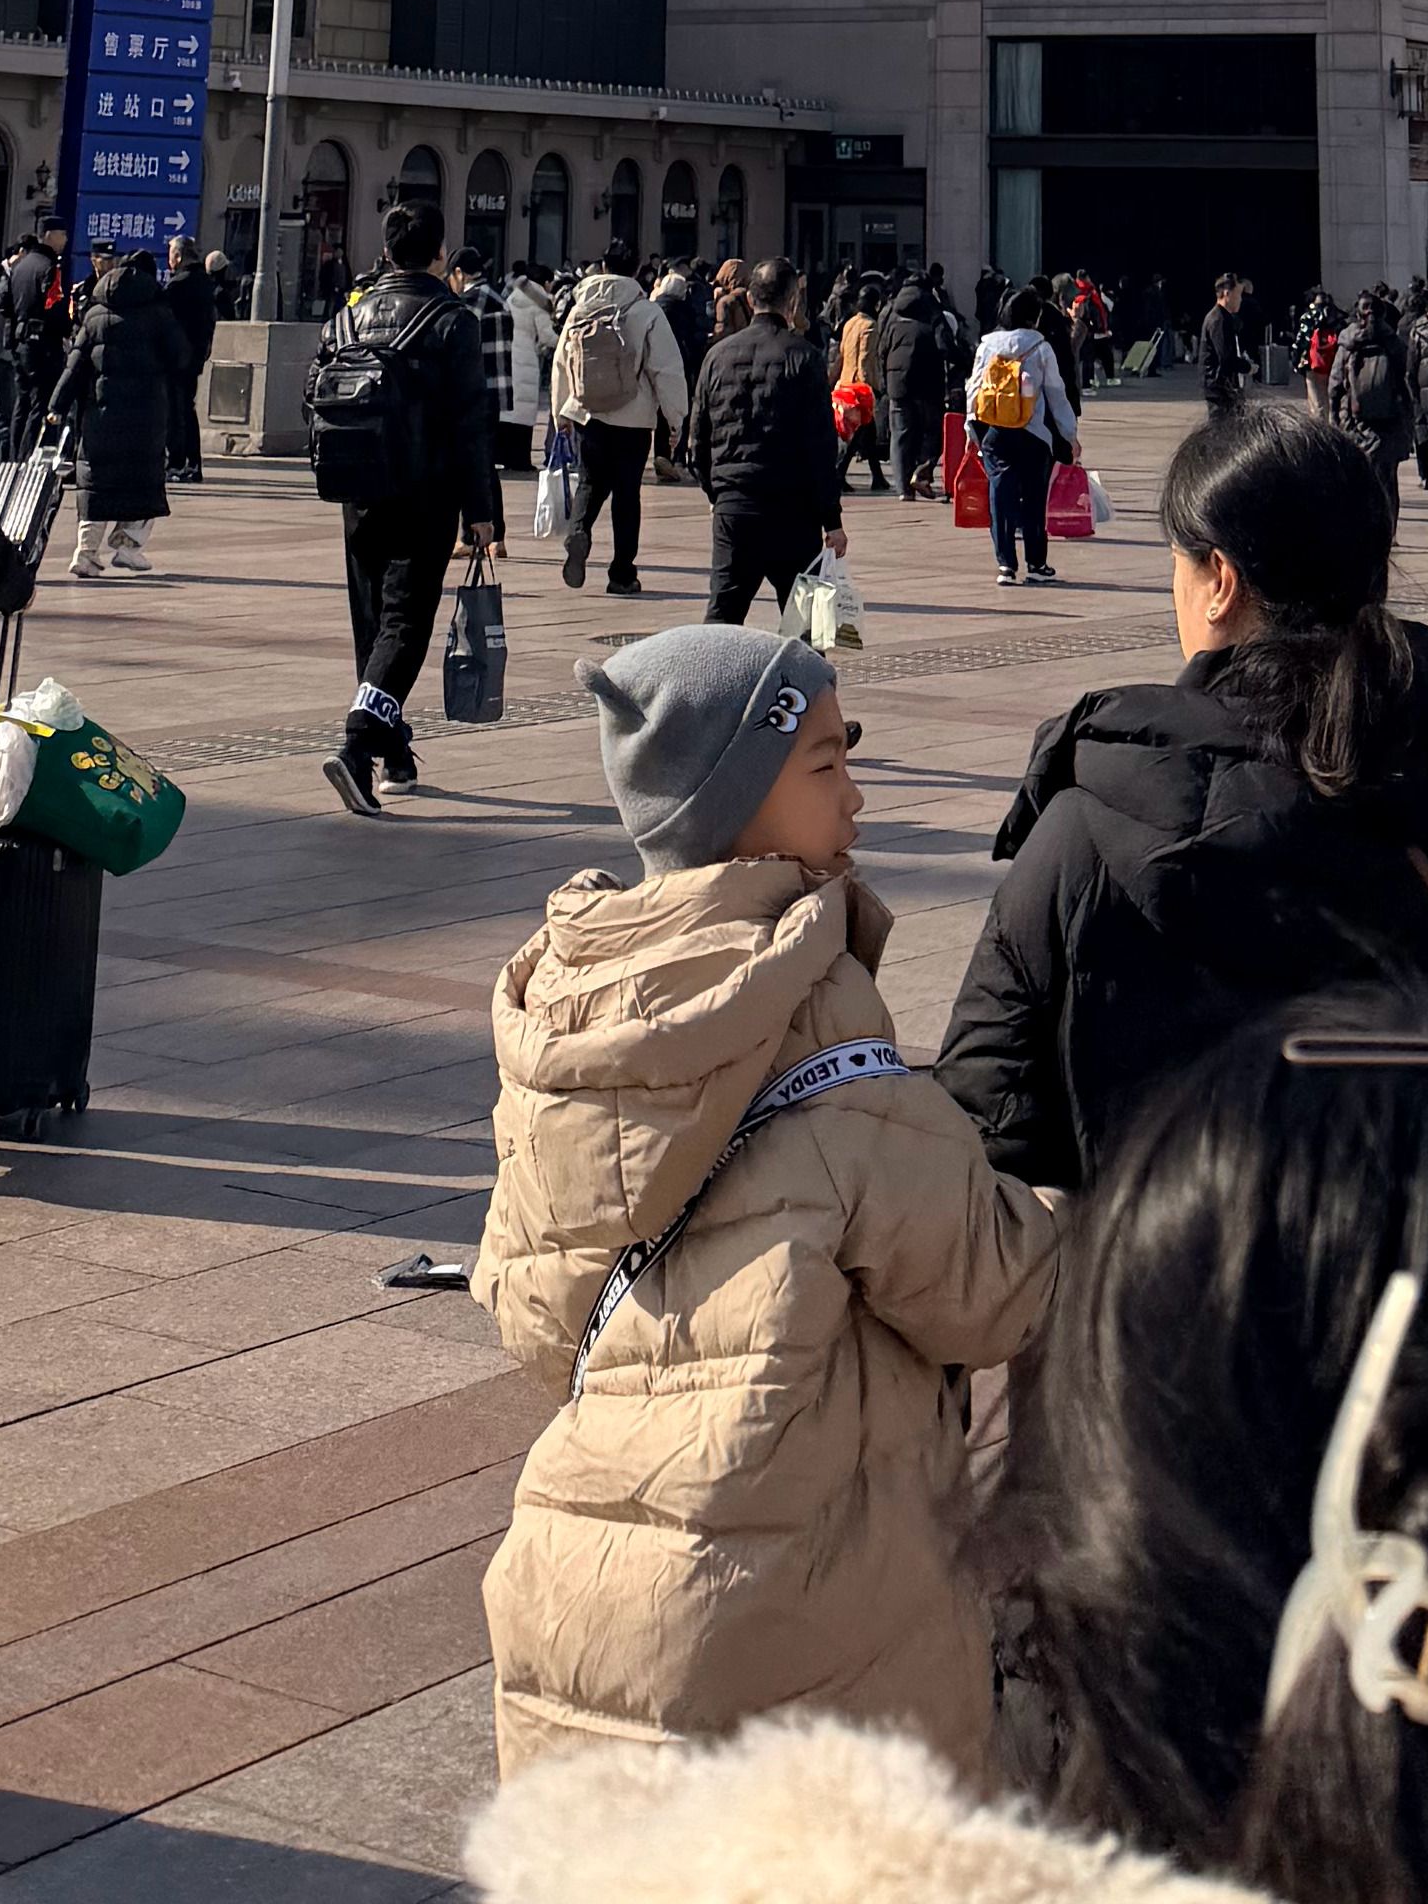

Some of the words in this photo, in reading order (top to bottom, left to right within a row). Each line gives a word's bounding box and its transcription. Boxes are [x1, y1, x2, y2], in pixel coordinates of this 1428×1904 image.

[104, 32, 170, 61] 售票厅
[97, 92, 166, 119] 进站口
[92, 150, 160, 178] 地铁进站口
[86, 212, 157, 240] 出租车调度站
